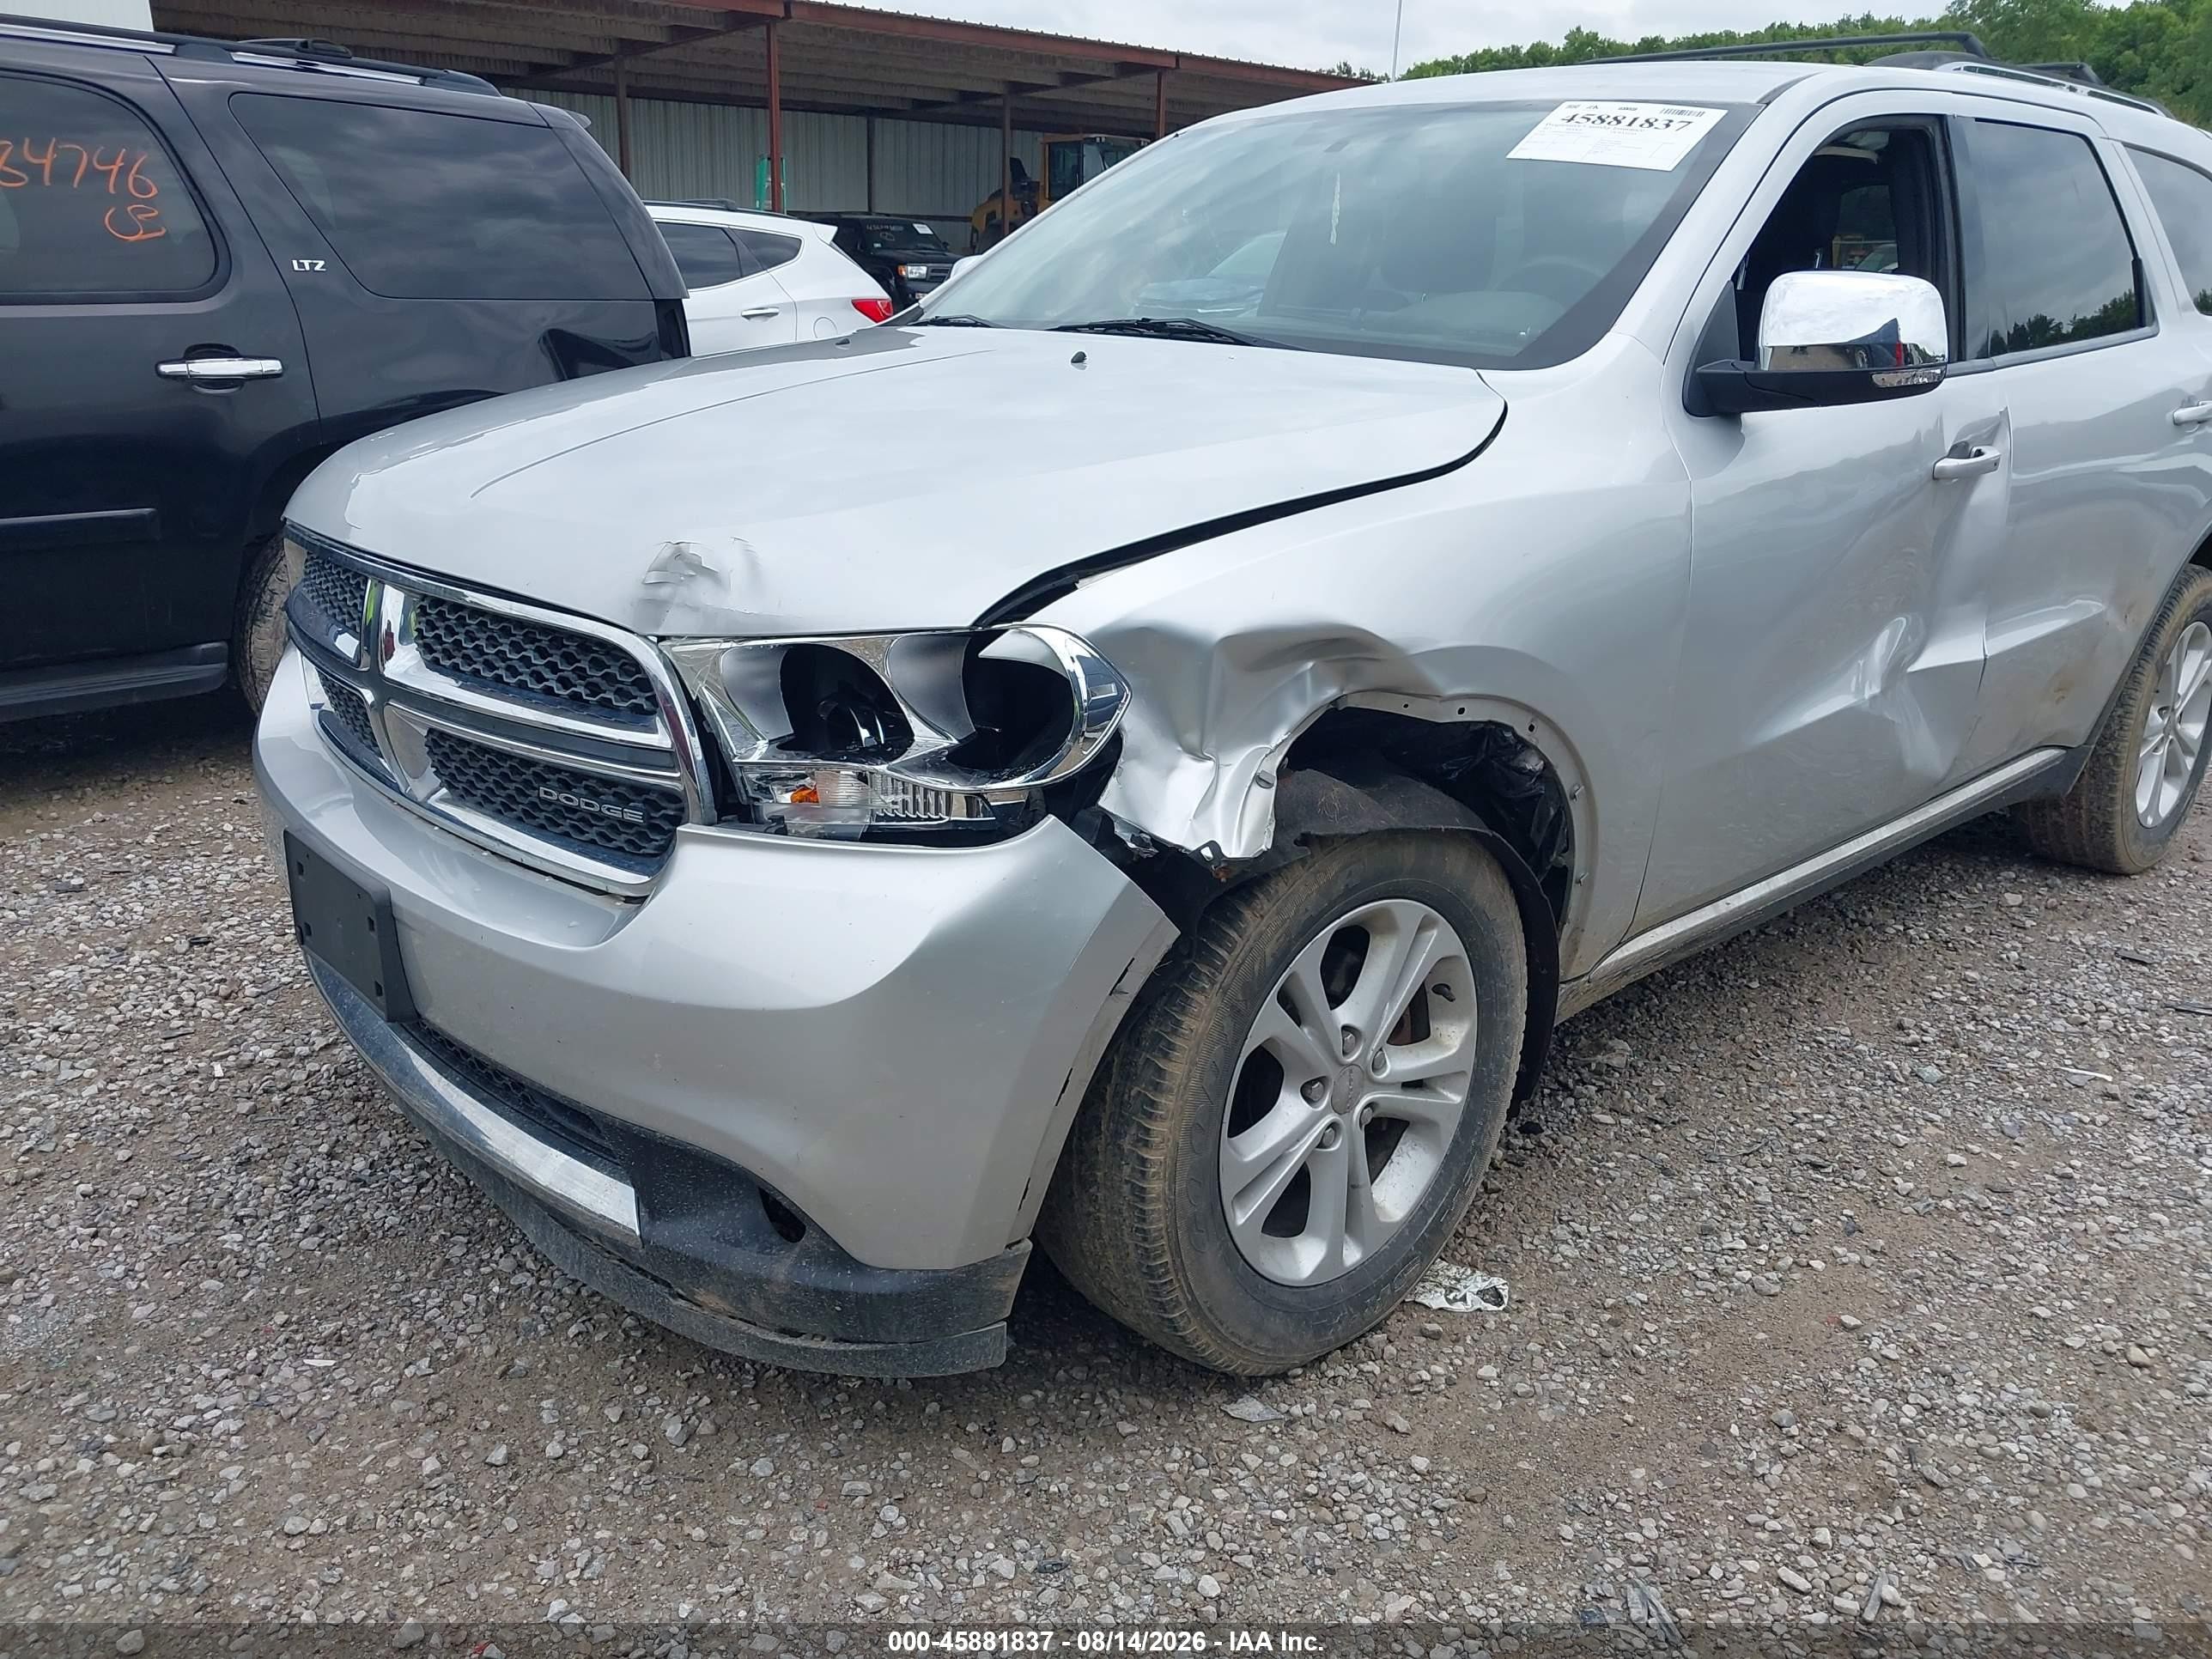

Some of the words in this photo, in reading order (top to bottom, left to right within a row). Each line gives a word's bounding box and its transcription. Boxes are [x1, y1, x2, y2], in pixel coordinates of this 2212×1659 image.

[1561, 113, 1693, 131] 45881837
[292, 259, 326, 271] LTZ
[539, 787, 644, 823] DODGE
